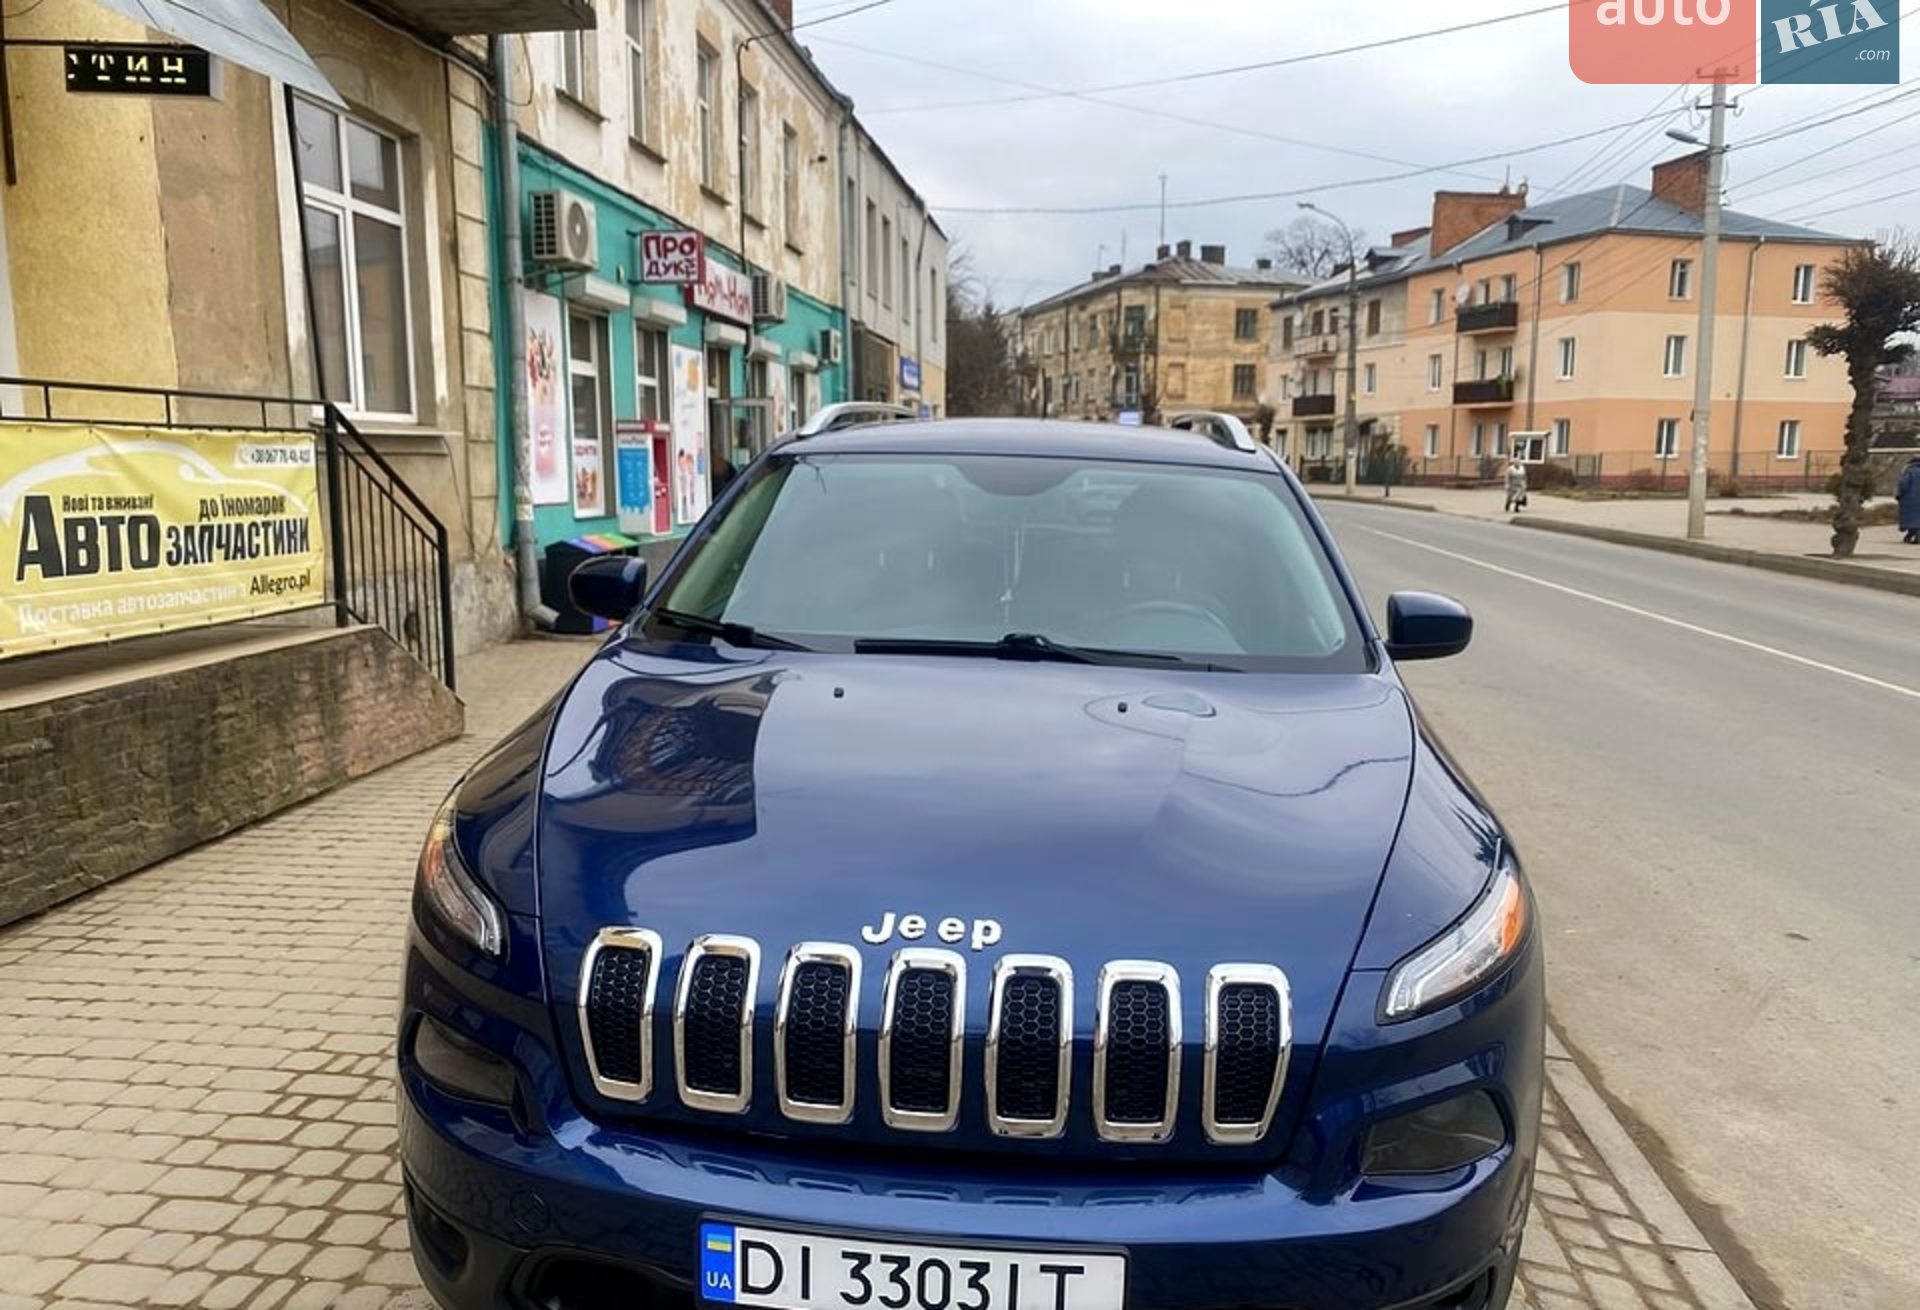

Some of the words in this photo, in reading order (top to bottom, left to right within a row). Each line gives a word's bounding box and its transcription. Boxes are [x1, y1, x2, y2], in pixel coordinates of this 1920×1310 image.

[643, 234, 697, 260] ПРО
[62, 493, 89, 513] Нові
[90, 495, 105, 511] та
[198, 498, 219, 522] до
[165, 516, 310, 568] ЗАПЧАСТИНИ
[250, 569, 311, 595] Allegro.pl
[18, 599, 113, 634] Доставка
[861, 911, 1002, 951] Jeep
[706, 1270, 732, 1290] UA
[740, 1239, 811, 1301] DI
